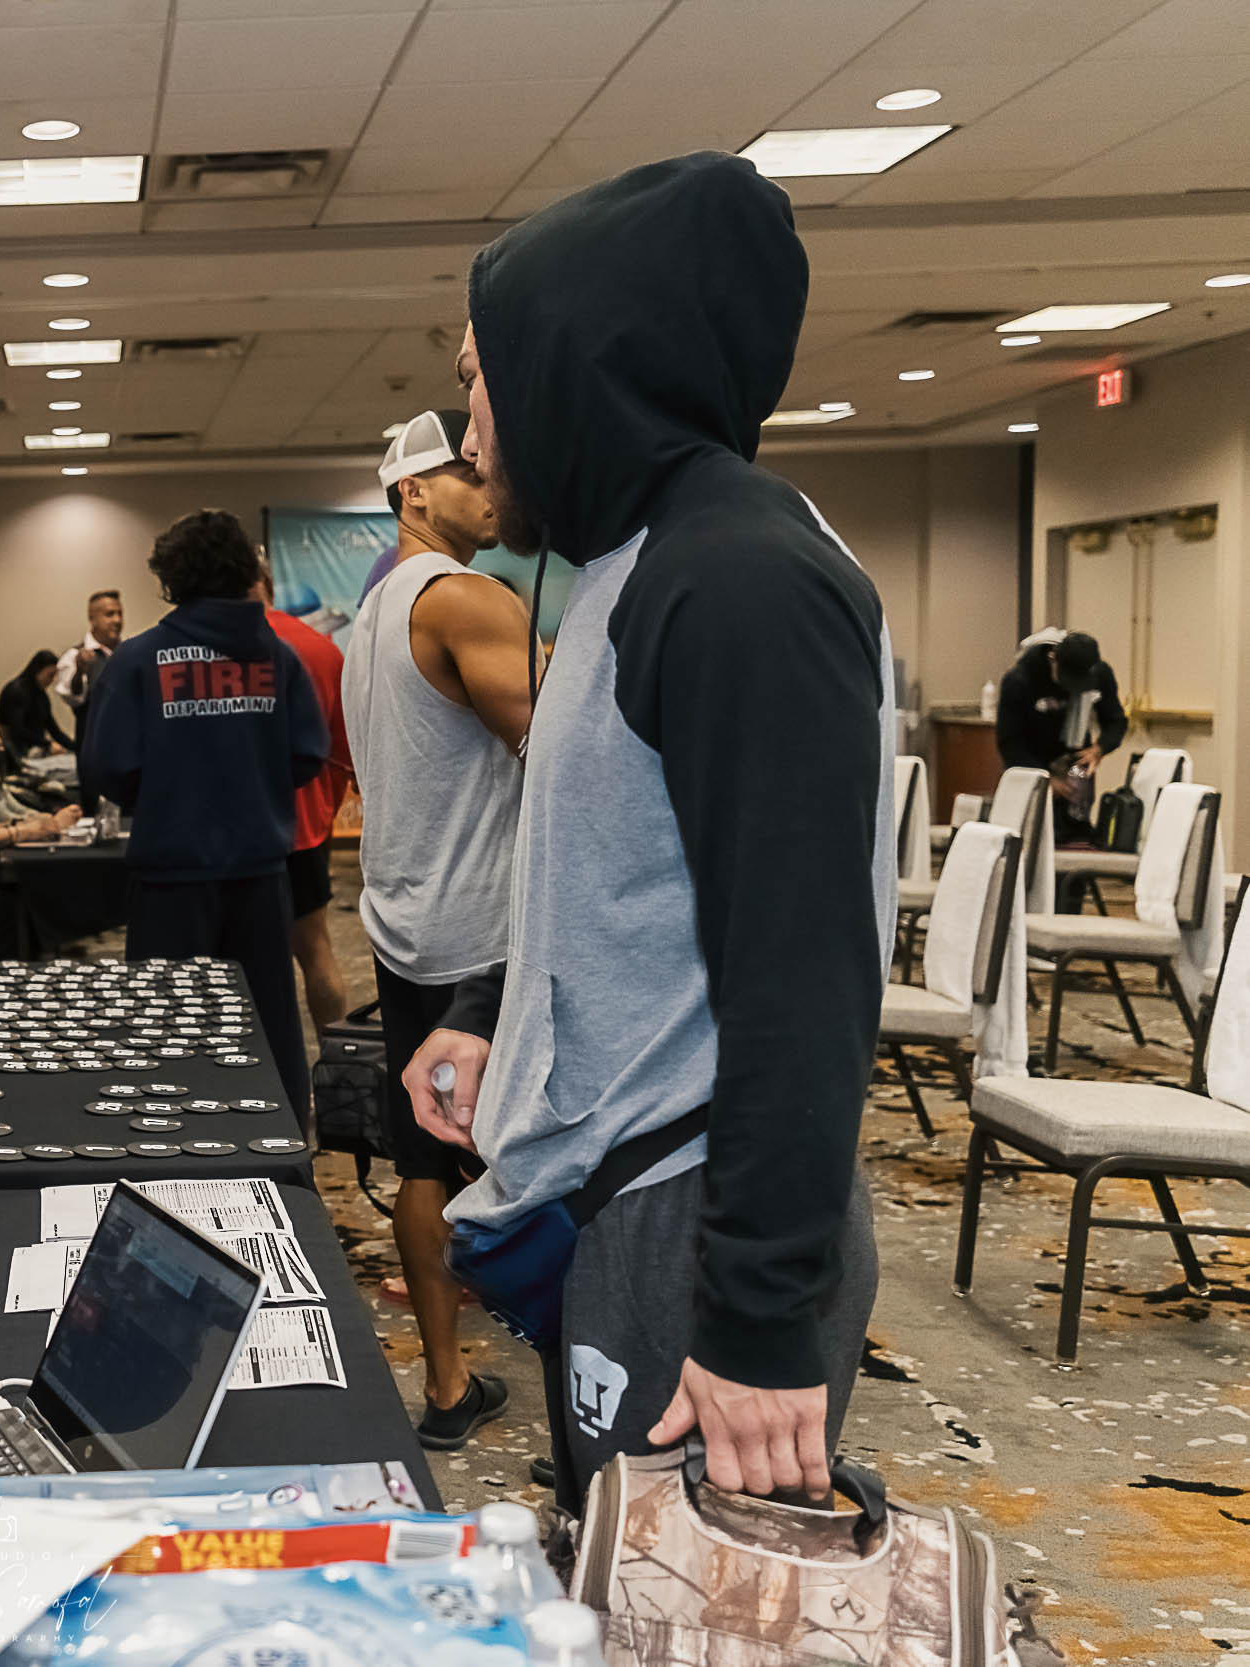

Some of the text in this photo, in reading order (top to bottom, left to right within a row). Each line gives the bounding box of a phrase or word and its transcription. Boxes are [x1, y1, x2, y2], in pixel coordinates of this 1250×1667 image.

[158, 661, 275, 703] FIRE
[145, 1102, 172, 1111] 27
[239, 1099, 266, 1109] 29
[141, 1118, 169, 1126] 17
[261, 1138, 290, 1149] 10
[34, 1145, 66, 1153] 5
